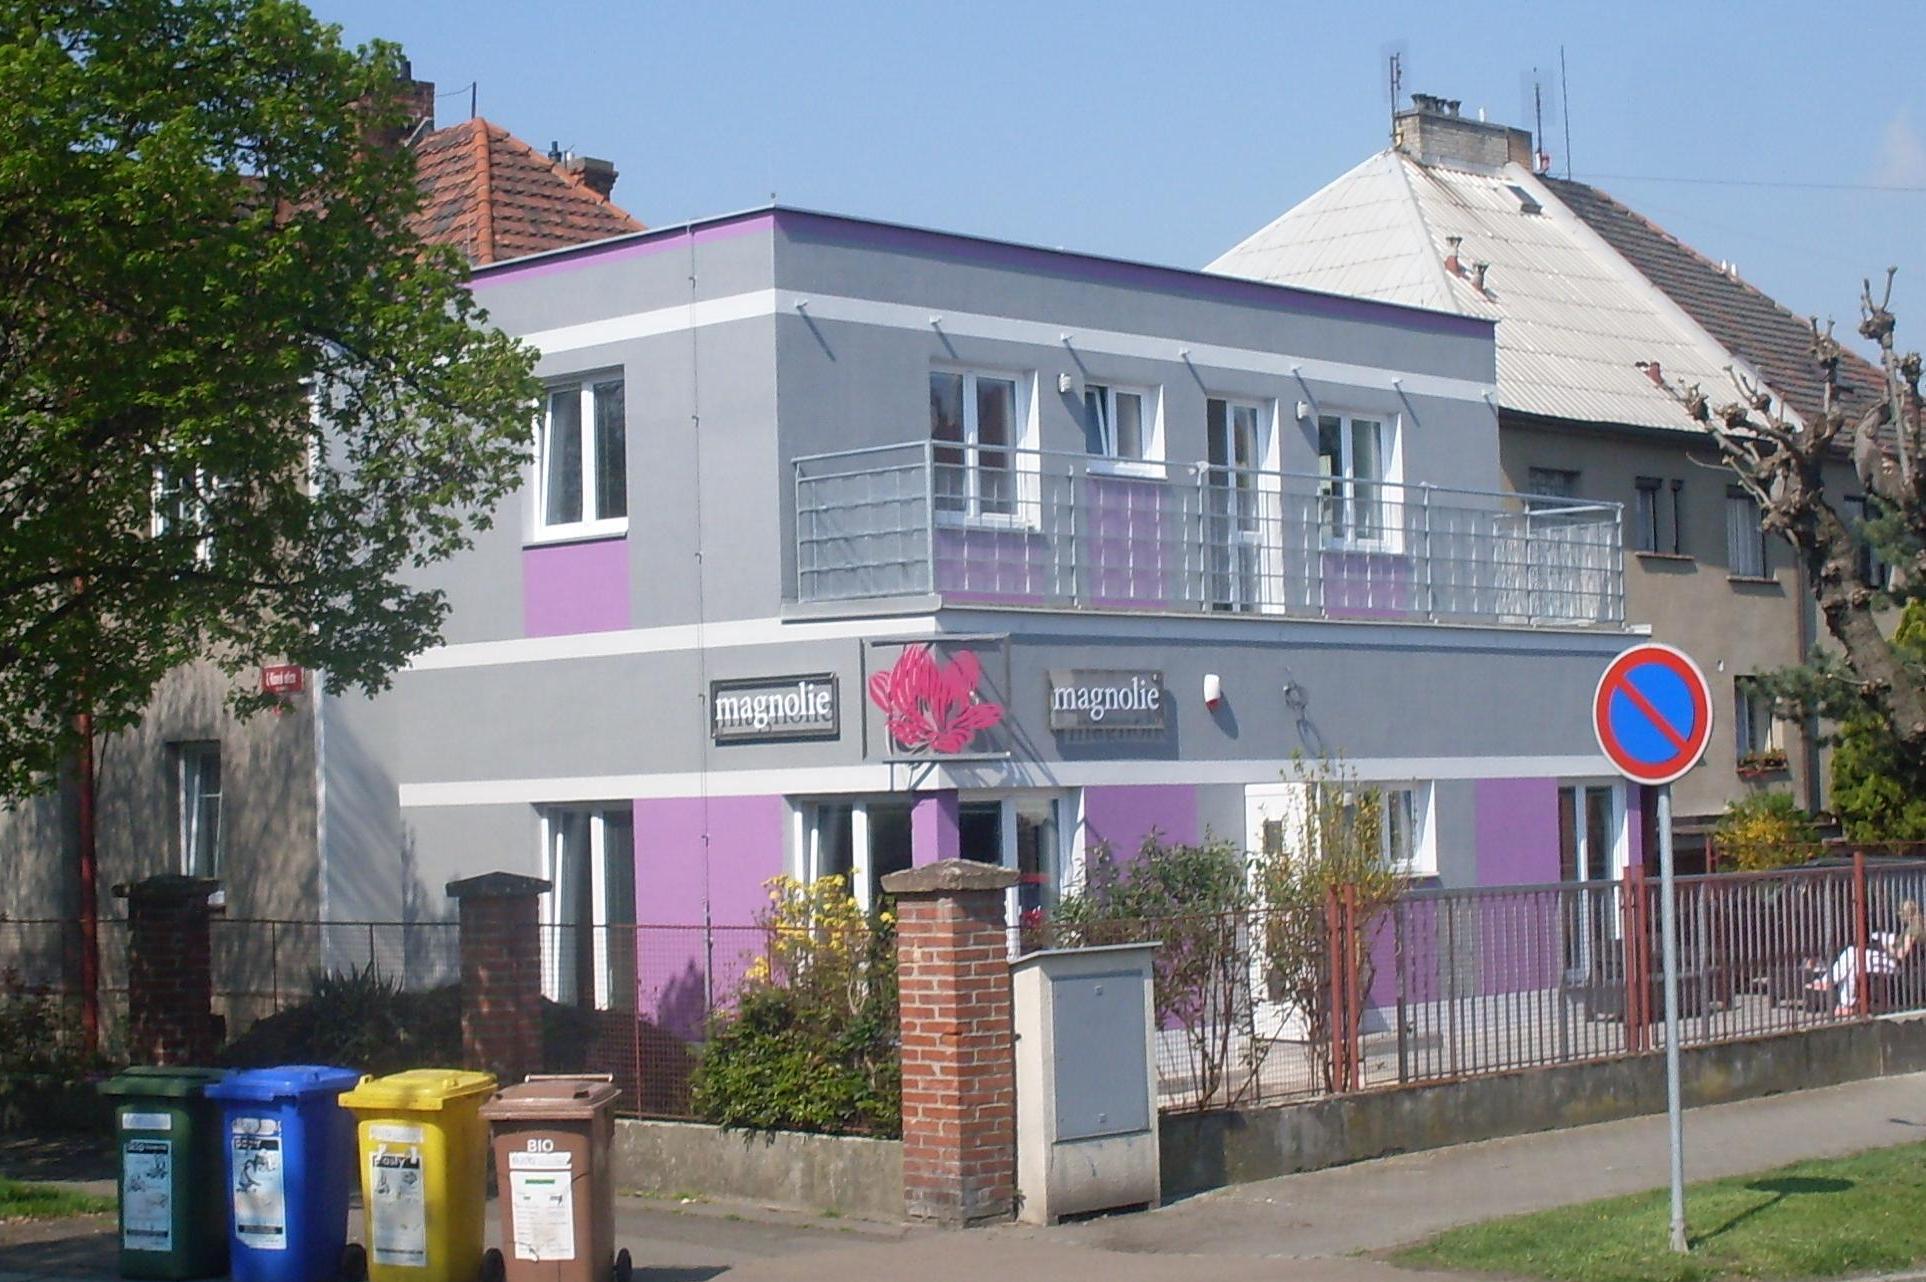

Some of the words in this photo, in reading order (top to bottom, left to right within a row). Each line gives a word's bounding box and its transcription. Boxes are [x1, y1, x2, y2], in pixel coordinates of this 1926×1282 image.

[716, 681, 830, 728] magnolie
[1054, 676, 1159, 720] magnolie
[527, 1139, 554, 1152] BIO
